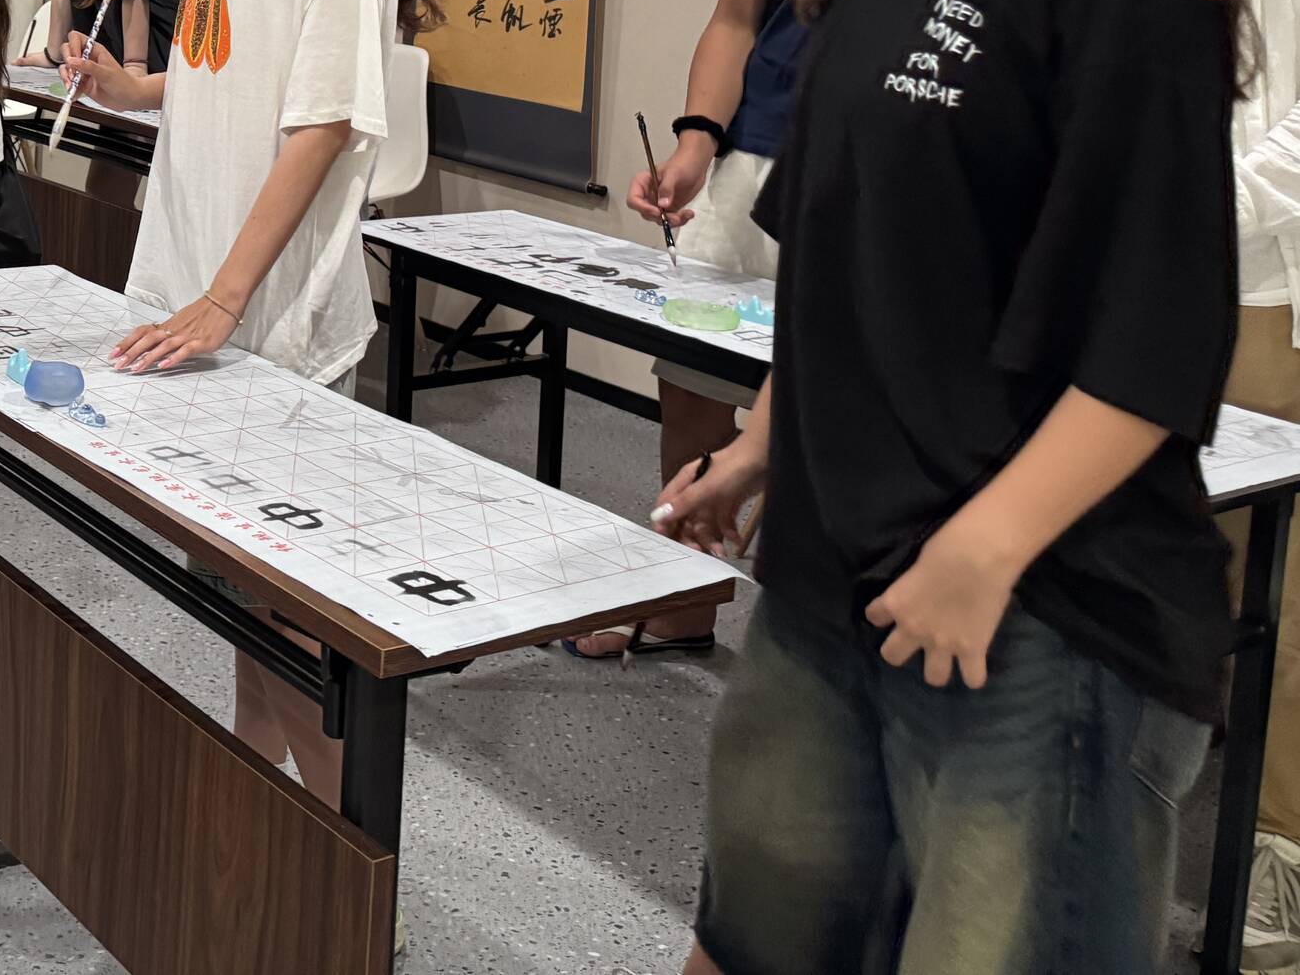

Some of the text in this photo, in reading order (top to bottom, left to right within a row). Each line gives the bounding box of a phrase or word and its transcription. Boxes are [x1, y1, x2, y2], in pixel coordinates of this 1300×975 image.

[923, 17, 983, 63] MONEY
[906, 52, 940, 79] FOR
[884, 73, 964, 108] PORSCHE
[258, 502, 324, 531] 中
[387, 570, 477, 606] 中
